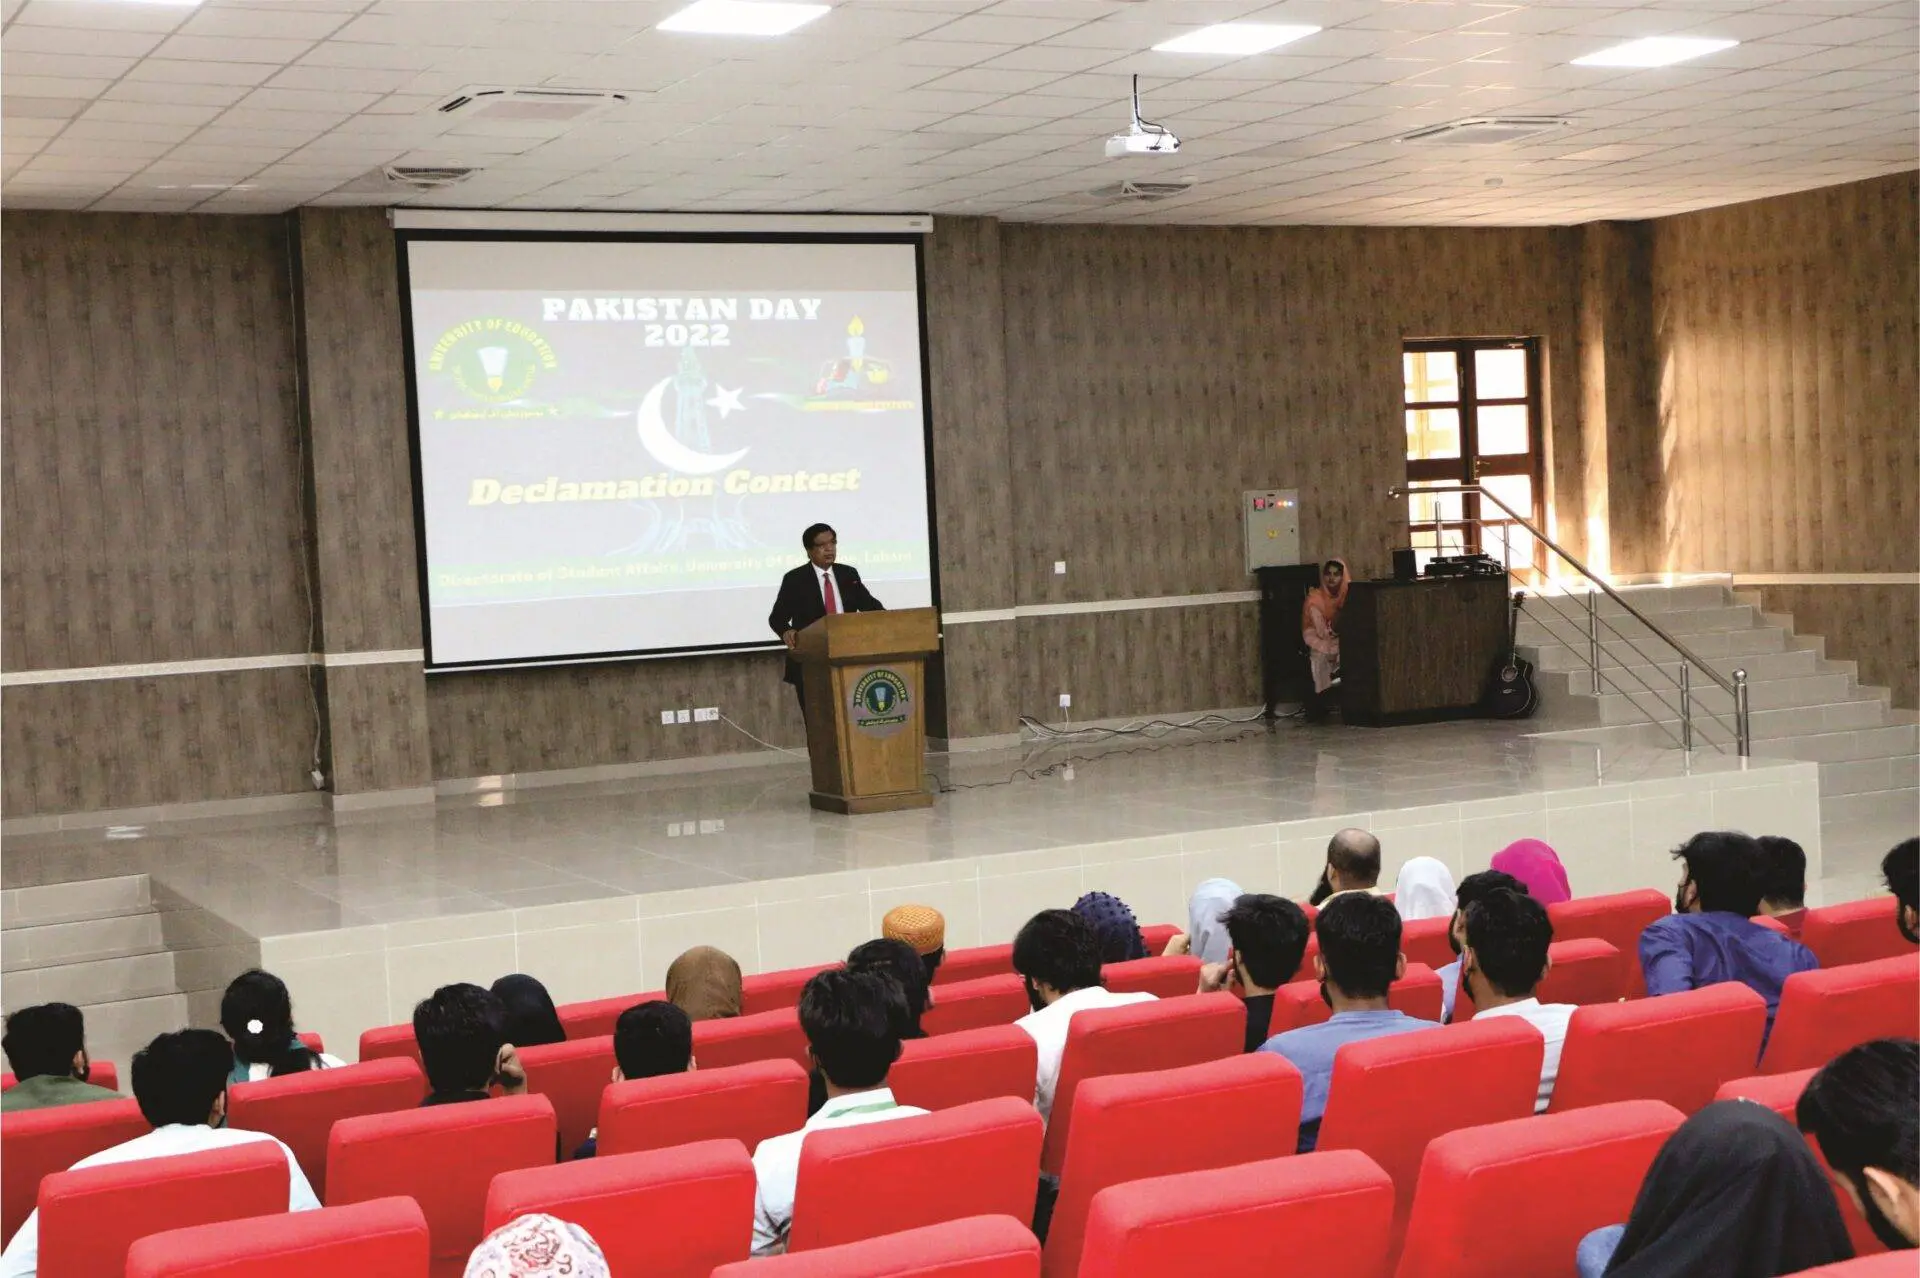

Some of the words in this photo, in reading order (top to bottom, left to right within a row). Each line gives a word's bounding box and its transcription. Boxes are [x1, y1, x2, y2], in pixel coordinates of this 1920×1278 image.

[542, 297, 737, 321] PAKISTAN
[749, 297, 822, 320] DAY
[429, 319, 482, 371] UNIVERSITY
[486, 318, 504, 331] OF
[505, 321, 558, 369] EDUCATION
[644, 323, 731, 347] 2022
[467, 472, 717, 506] Declamation
[723, 467, 861, 495] Contest
[438, 570, 534, 588] Directorate
[557, 562, 622, 580] Student
